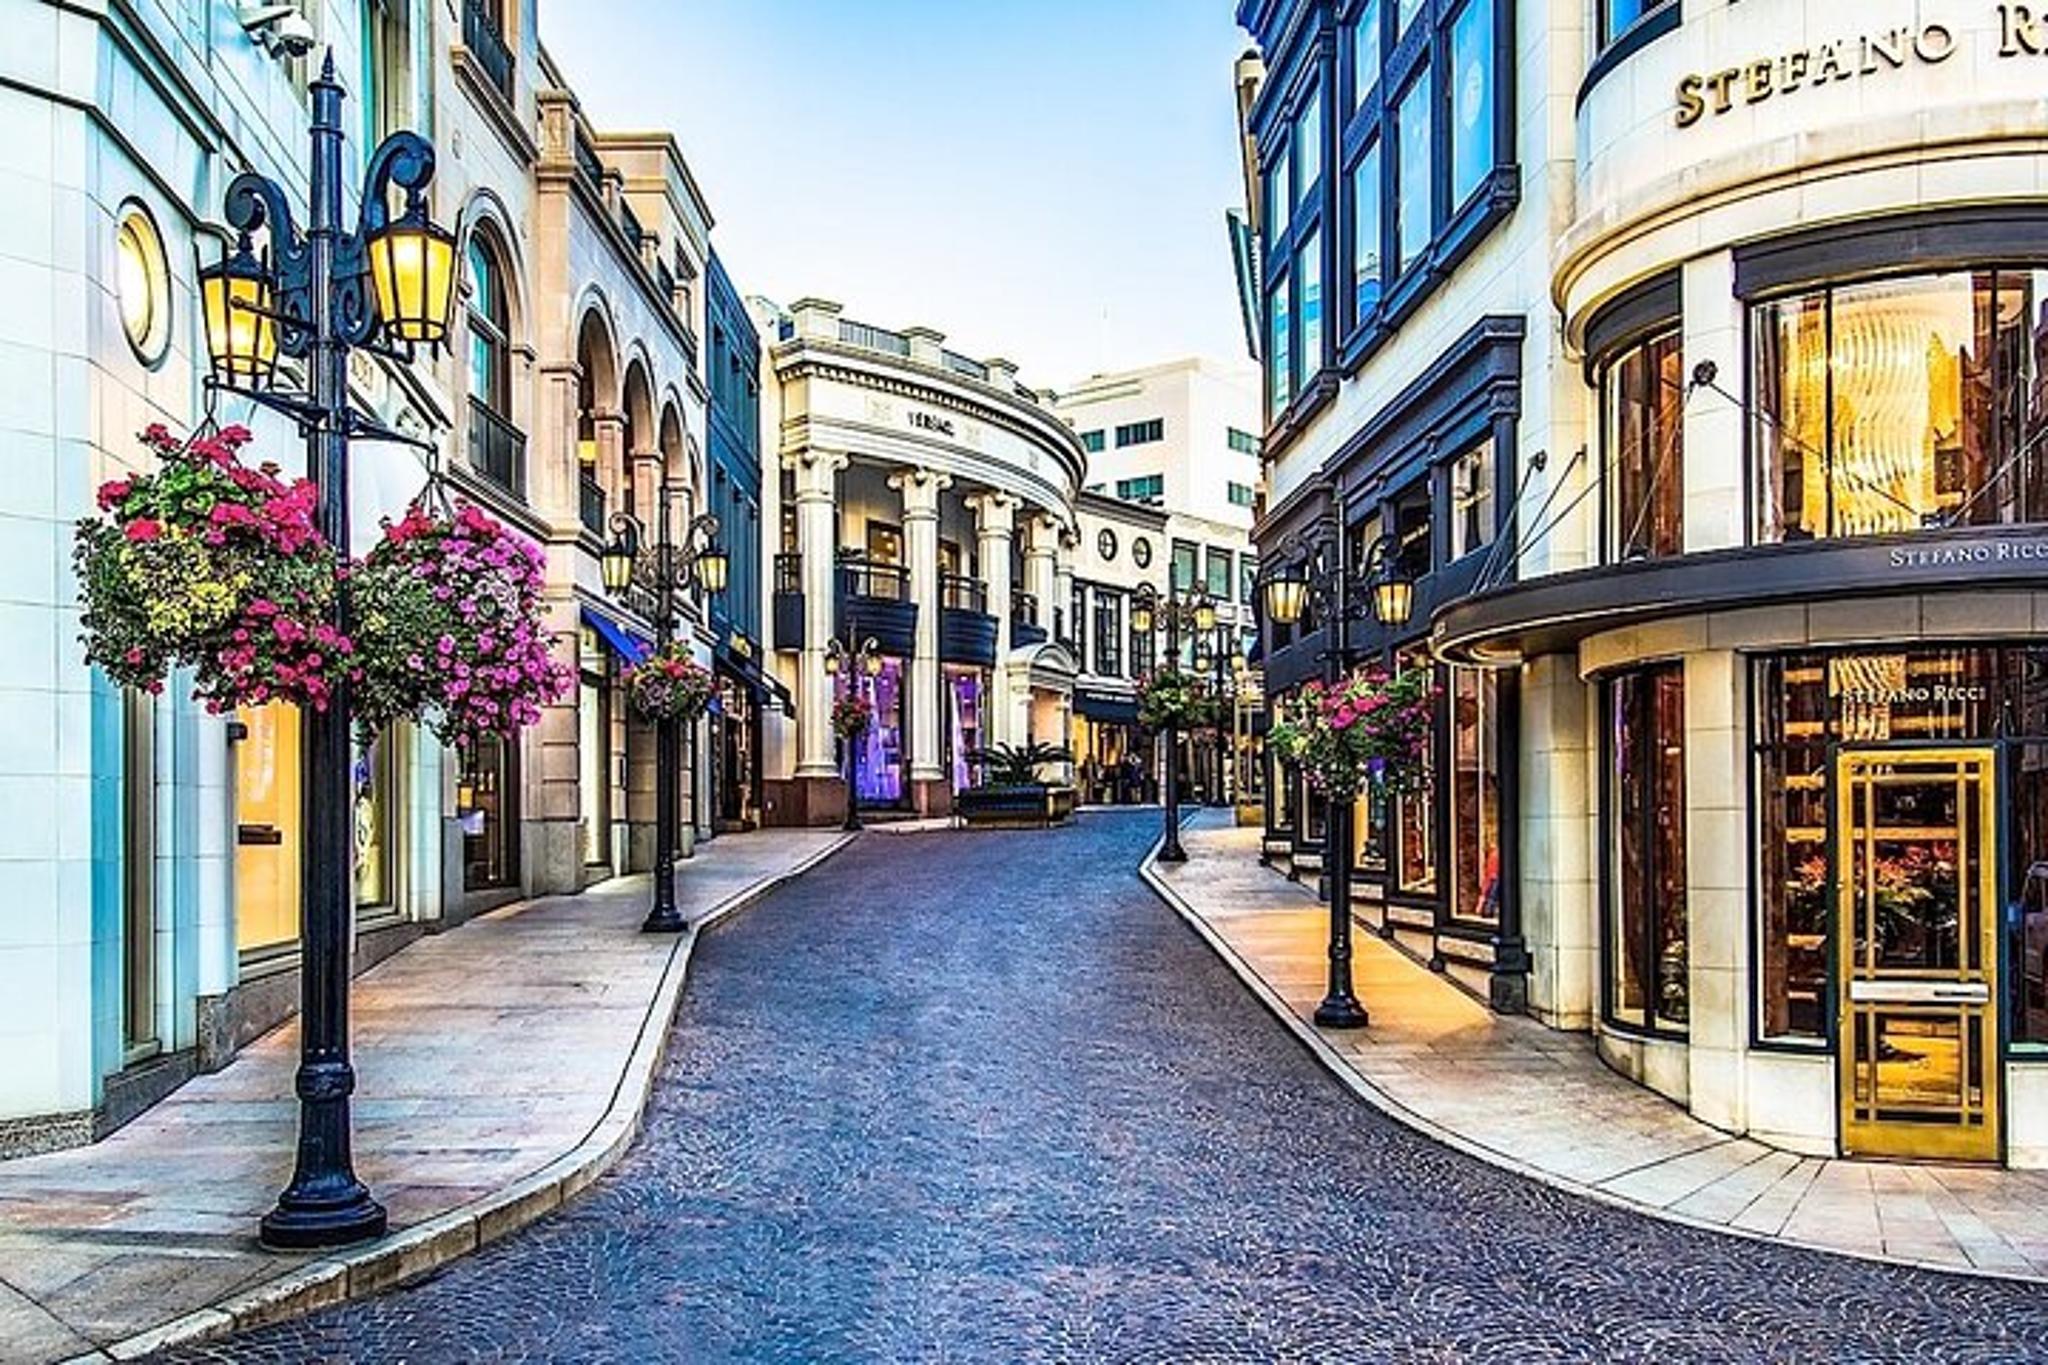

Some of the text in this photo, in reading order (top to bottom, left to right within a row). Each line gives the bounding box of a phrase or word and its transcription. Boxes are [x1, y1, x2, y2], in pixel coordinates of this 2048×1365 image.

[1675, 3, 2048, 128] STEFANO R
[1890, 547, 1990, 567] STEFANO
